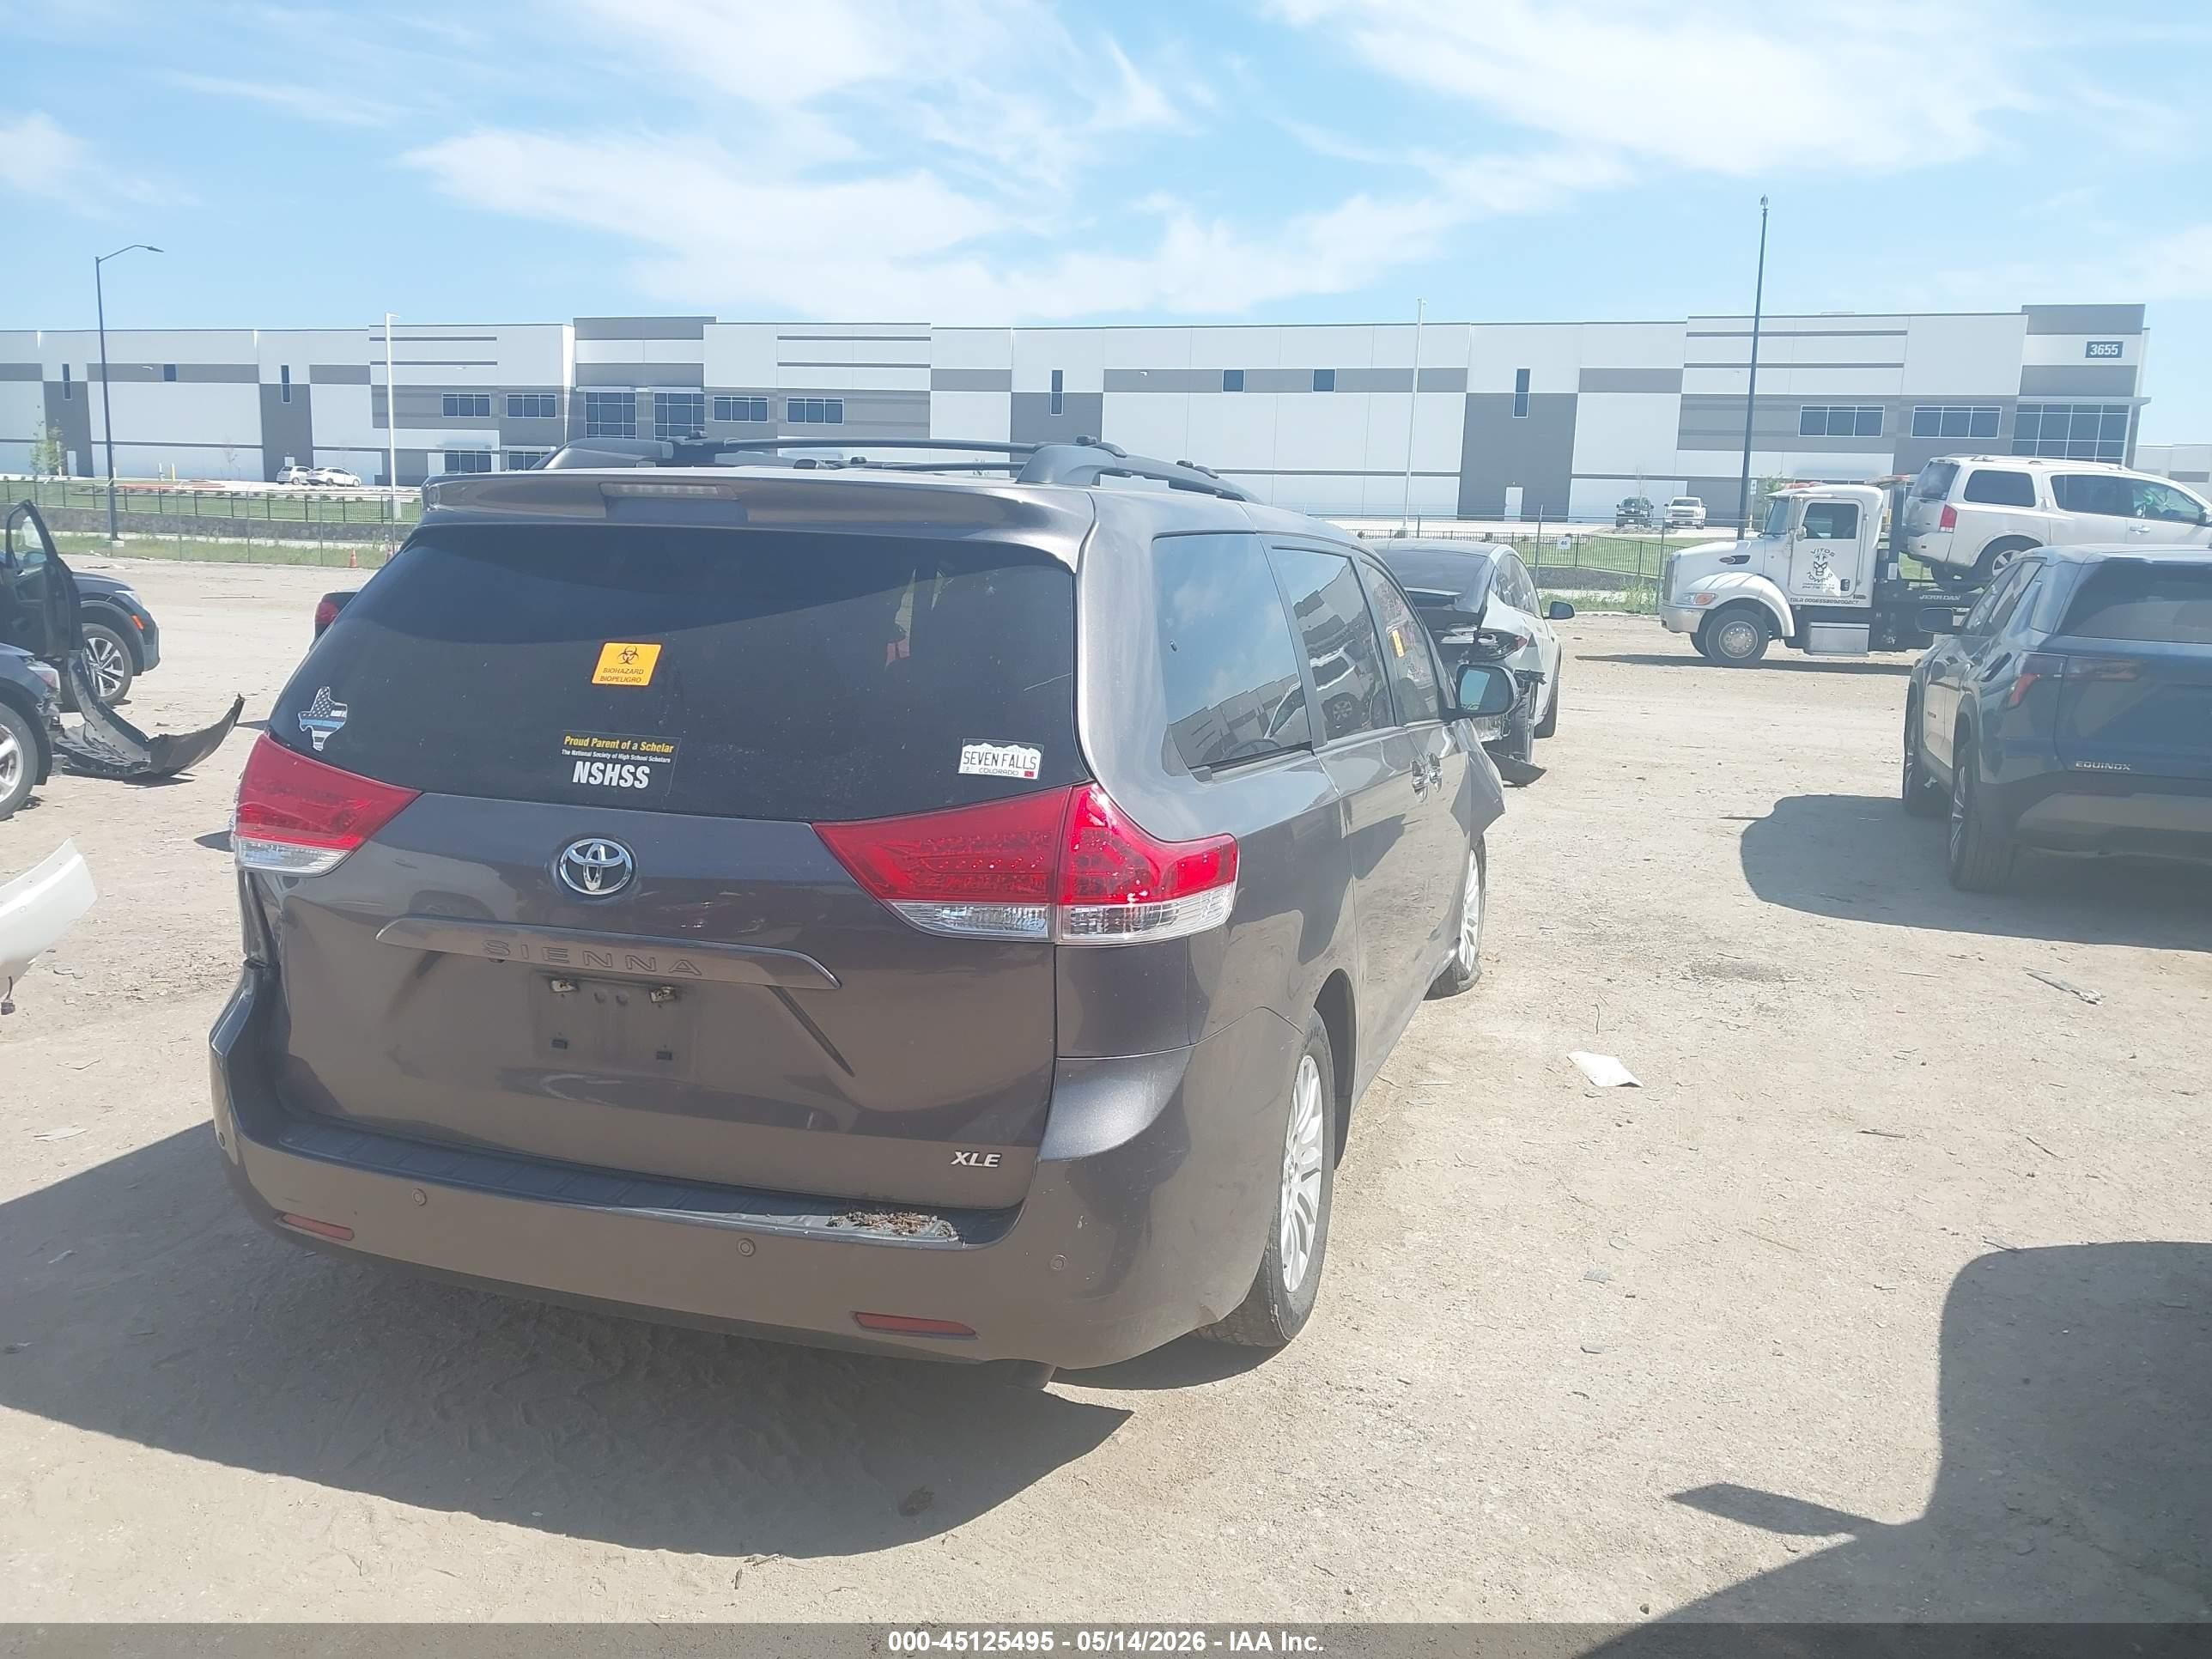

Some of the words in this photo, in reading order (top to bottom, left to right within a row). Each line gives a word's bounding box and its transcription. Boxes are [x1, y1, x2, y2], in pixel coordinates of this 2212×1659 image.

[2089, 343, 2119, 356] 3655
[599, 675, 642, 684] BIOPELIGRO
[563, 736, 589, 747] Proud
[591, 738, 619, 749] Parent
[621, 740, 631, 750] of
[631, 742, 638, 750] a
[640, 741, 674, 753] Scholar
[963, 750, 1000, 767] SEVEN
[1001, 753, 1037, 770] FALLS
[2075, 761, 2131, 771] EQUINOX
[572, 761, 651, 789] NSHSS
[978, 767, 1019, 776] COLORADO
[482, 939, 702, 976] SIENNA
[950, 1151, 1001, 1168] XLE
